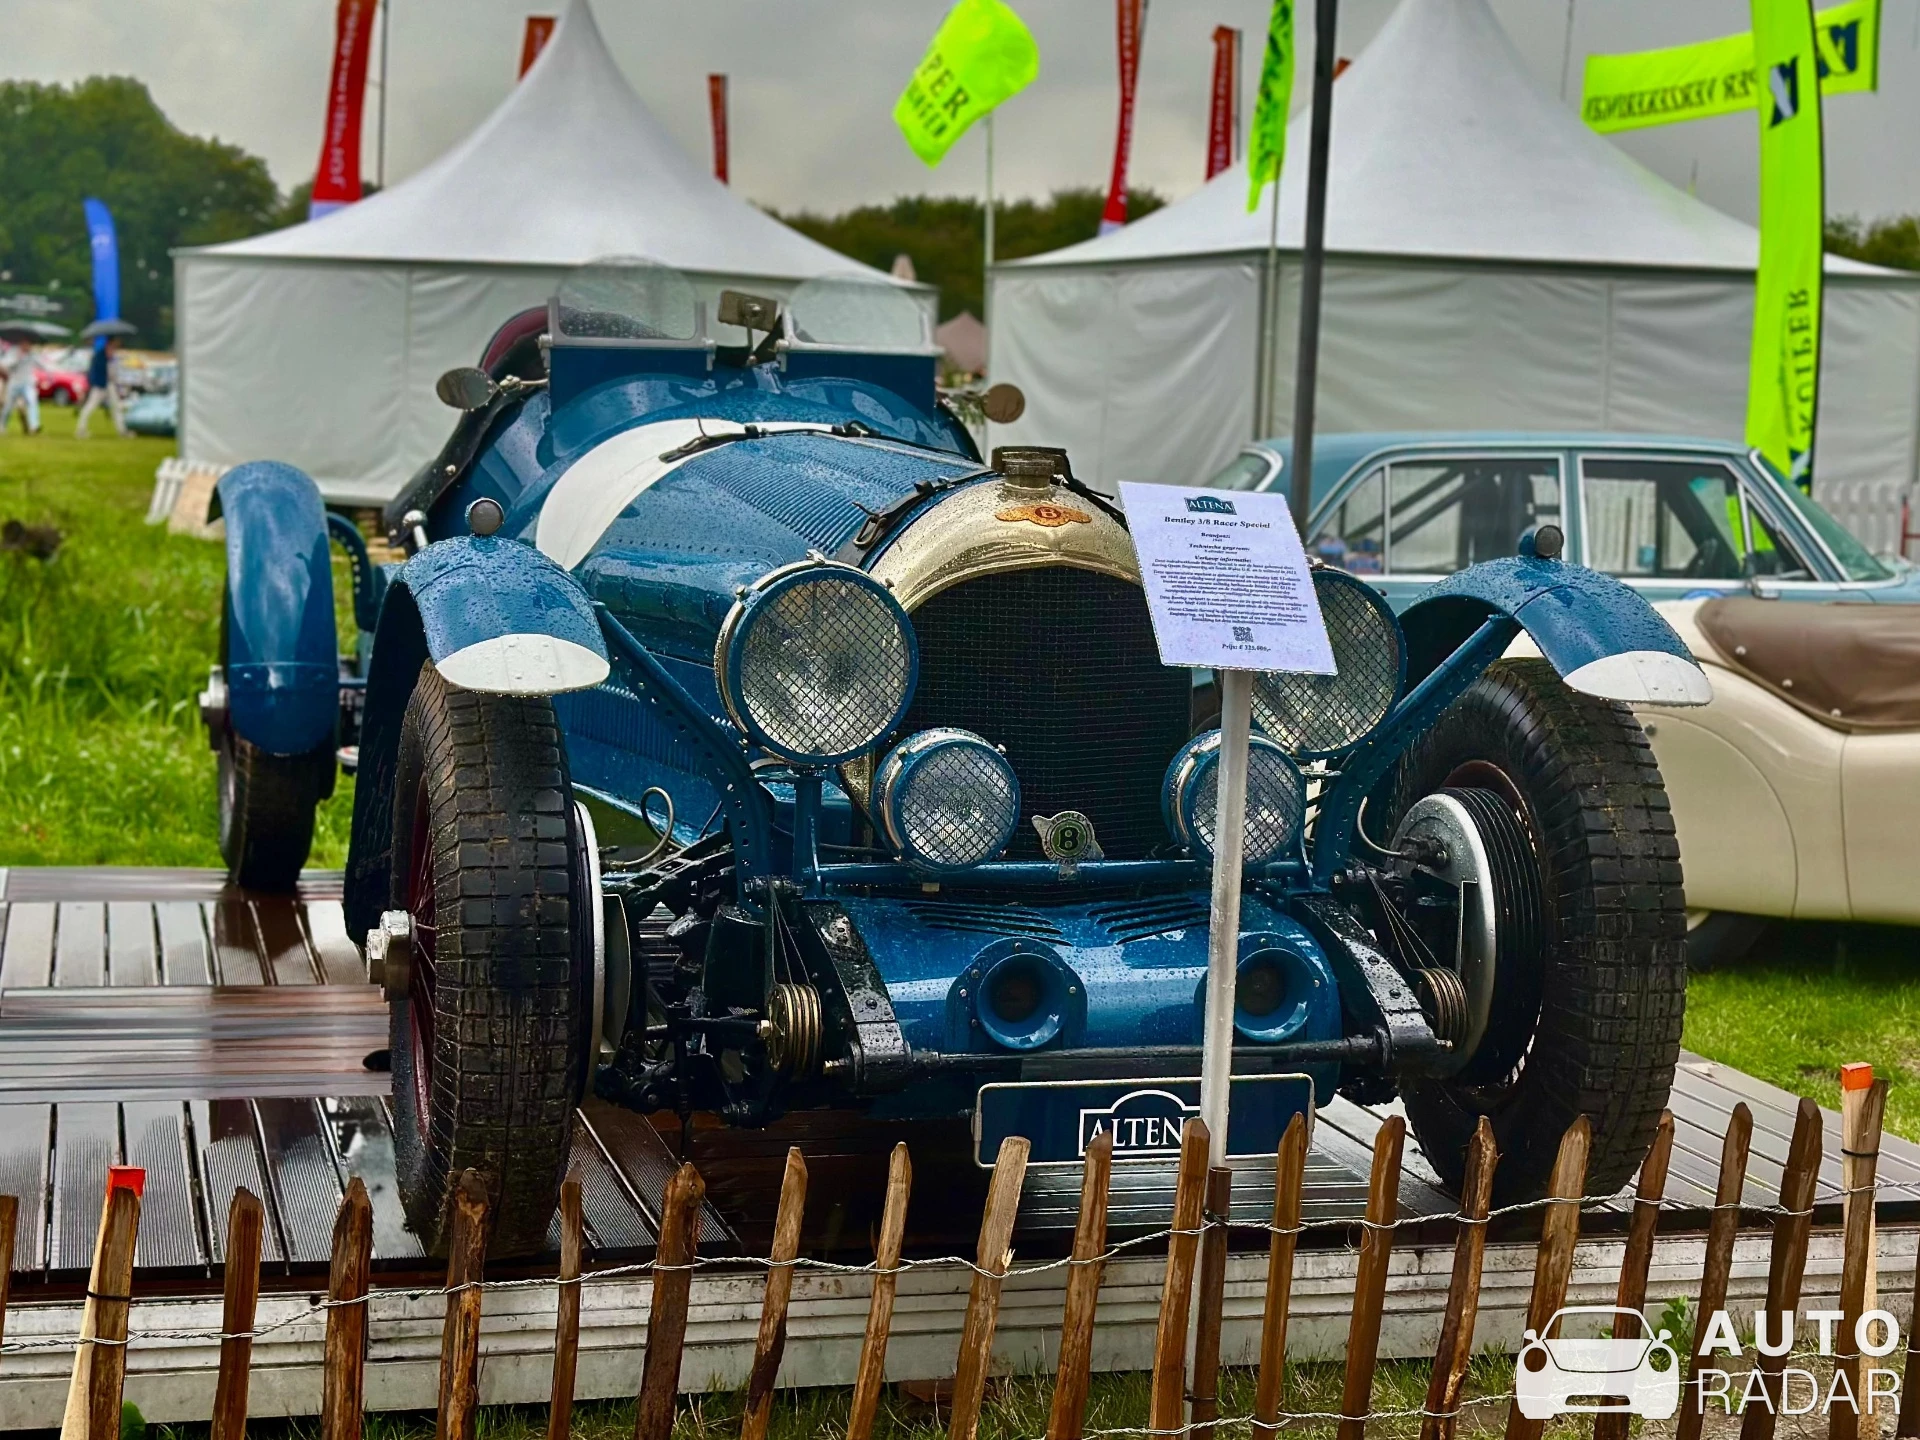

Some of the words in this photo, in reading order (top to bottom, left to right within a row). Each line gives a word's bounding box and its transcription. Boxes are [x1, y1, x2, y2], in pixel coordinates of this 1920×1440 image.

[921, 53, 970, 121] PER
[1189, 500, 1232, 510] ALTENA
[1164, 516, 1196, 526] Bentley
[1213, 519, 1238, 527] Racer
[1239, 521, 1270, 529] Special
[1085, 1116, 1187, 1147] ALTEN
